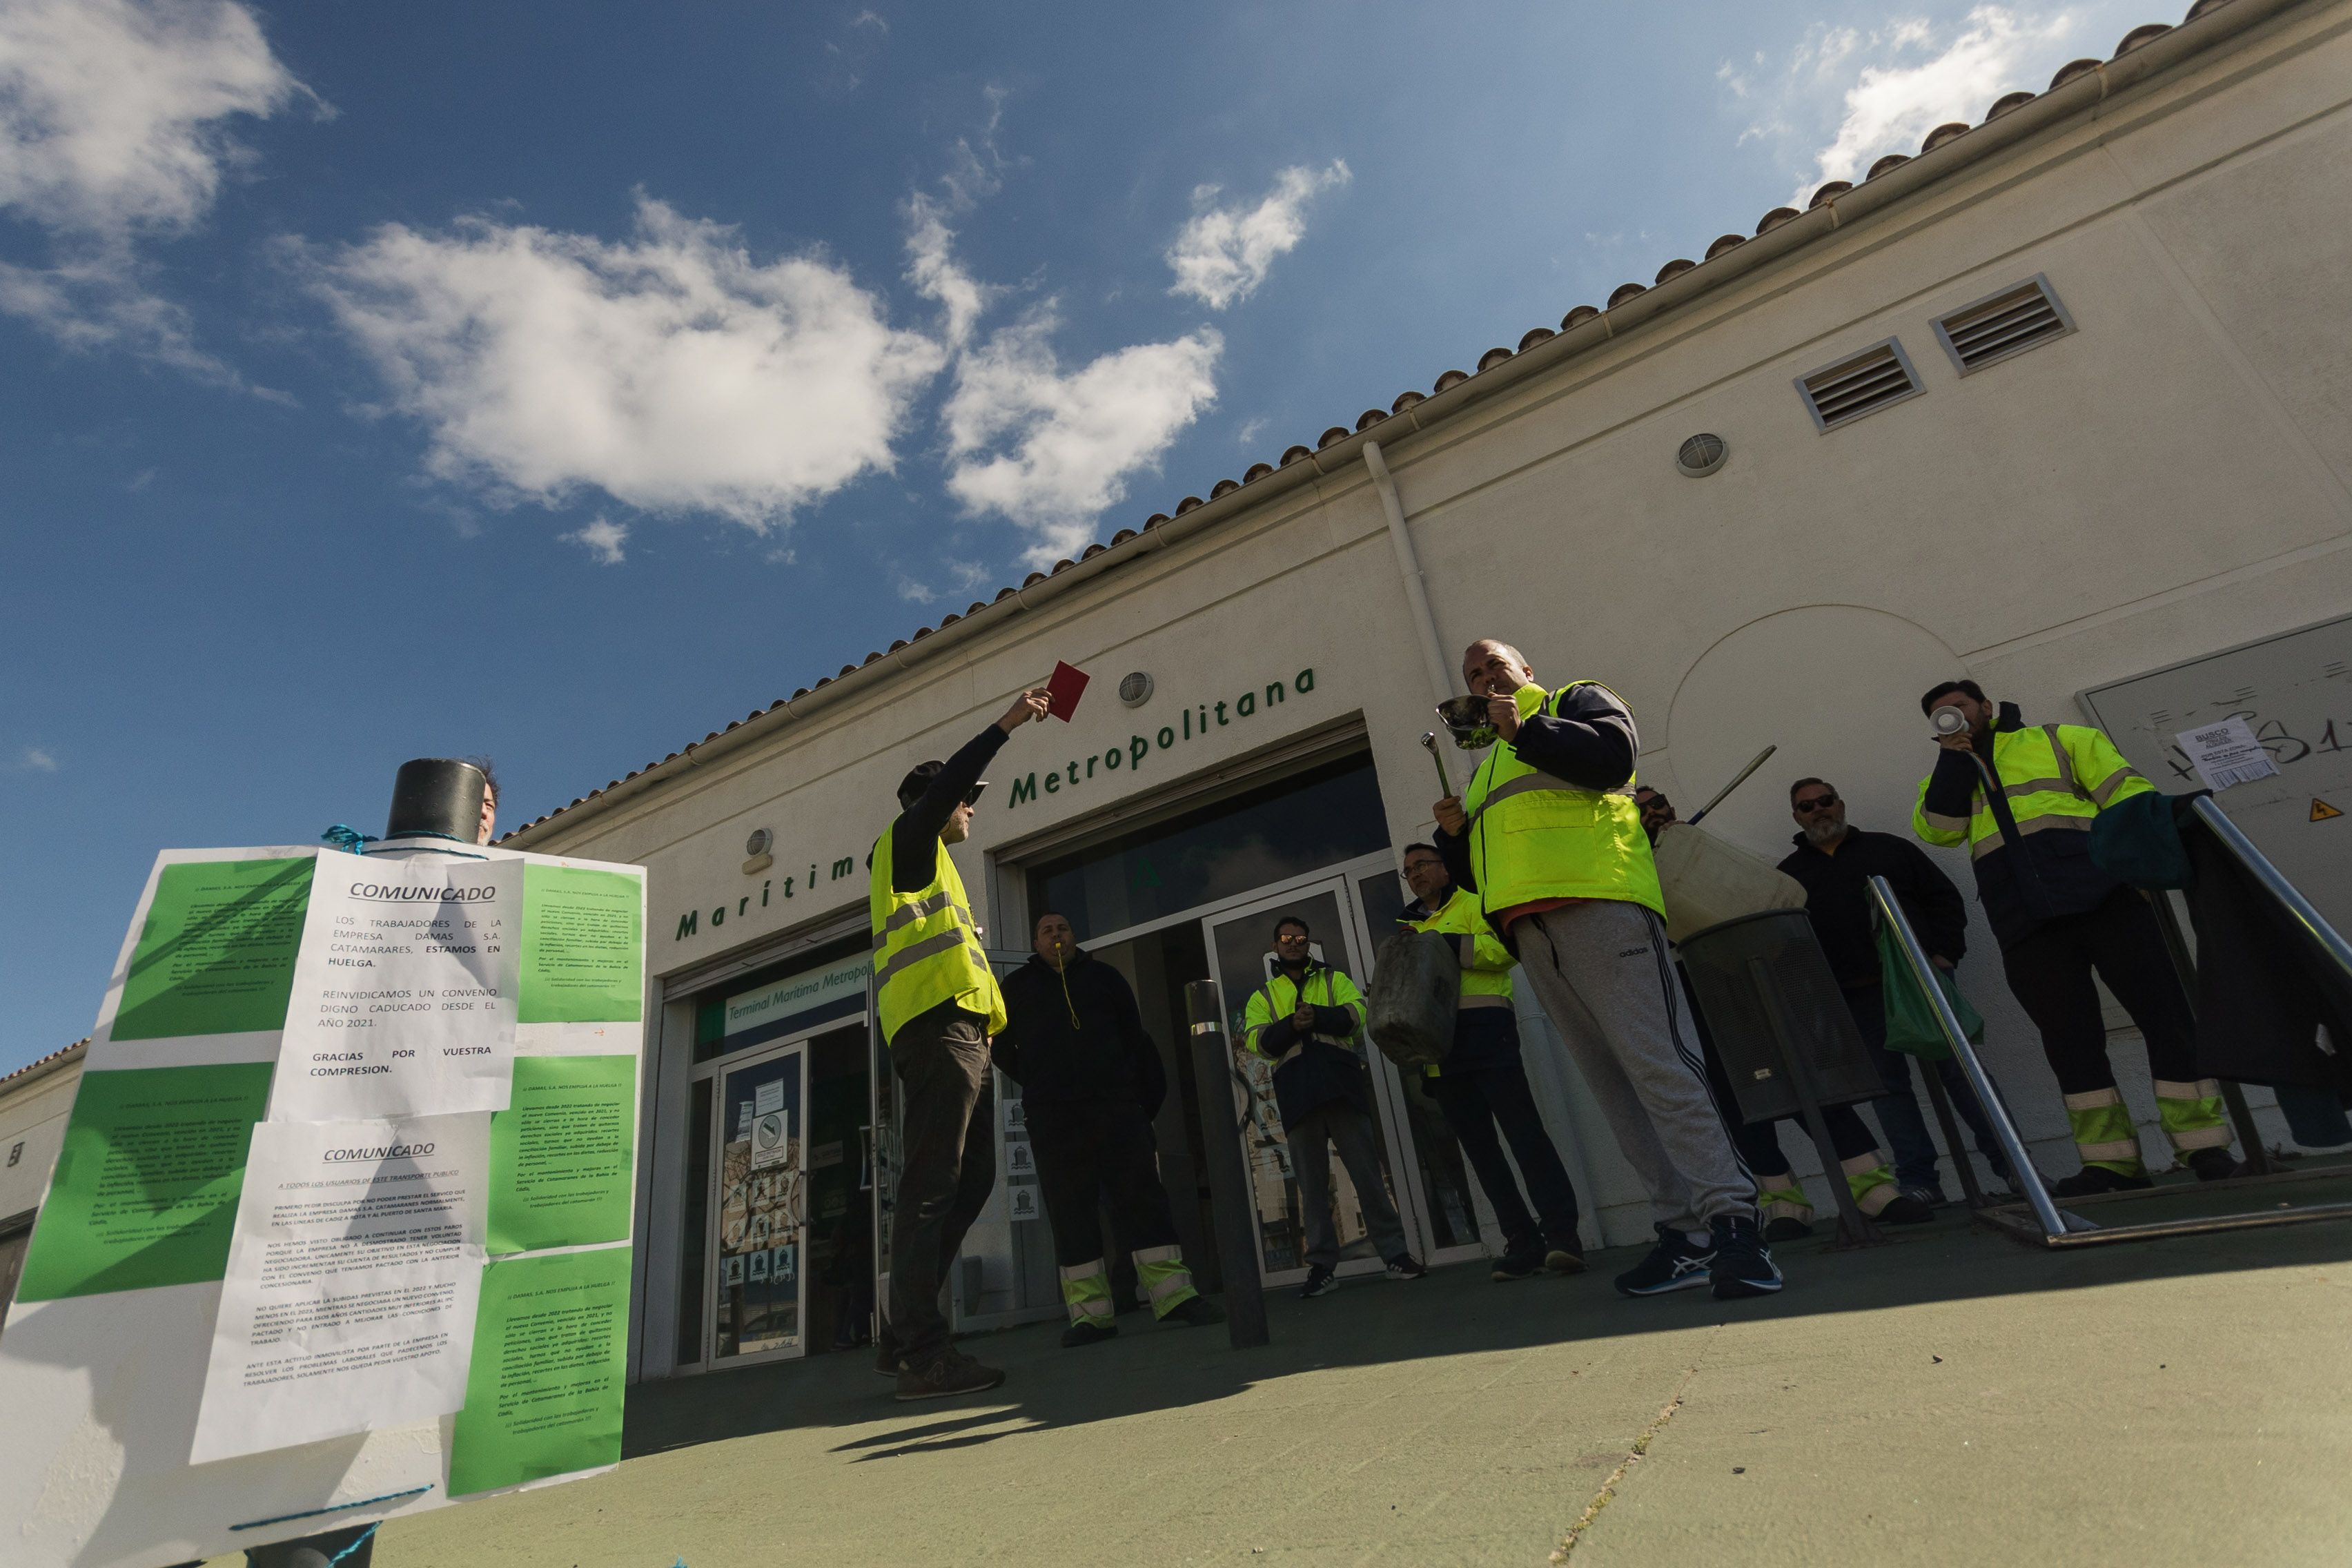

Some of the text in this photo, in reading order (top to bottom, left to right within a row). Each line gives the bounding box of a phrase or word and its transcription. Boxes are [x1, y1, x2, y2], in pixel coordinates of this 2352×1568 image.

[1008, 668, 1314, 809] Metropolitana
[2195, 728, 2229, 743] BUSCO
[350, 883, 496, 901] COMUNICADO
[676, 856, 853, 941] Marítim
[335, 916, 354, 925] LOS
[371, 918, 450, 928] TRABAJADORES
[490, 919, 501, 928] LA
[333, 930, 501, 941] EMPRESA DAMAS S.A.
[331, 944, 500, 954] CATAMARARES, ESTAMOS EN
[1619, 947, 1648, 957] adidas
[329, 958, 377, 967] HUELGA.
[322, 988, 497, 999] REINVIDICAMOS UN CONVENIO
[320, 1001, 496, 1013] DIGNO CADUCADO DESDE EL
[729, 994, 770, 1020] Terminal
[772, 981, 819, 1006] Marítima
[317, 1017, 378, 1028] AÑO 2021.
[313, 1046, 491, 1061] GRACIAS POR VUESTRA
[311, 1066, 393, 1076] COMPRESION.
[324, 1143, 435, 1161] COMUNICADO
[389, 1173, 430, 1181] TRANSPORTE
[375, 1202, 418, 1210] CATAMARANES
[371, 1230, 406, 1238] CONTINUAR
[315, 1251, 354, 1260] UNICAMENTE
[366, 1246, 394, 1254] OBJETIVO
[422, 1238, 461, 1247] NEGOCIACION
[288, 1270, 322, 1278] CONVENIO
[341, 1264, 372, 1272] TENIAMOS
[431, 1253, 460, 1262] ANTERIOR
[291, 1260, 335, 1270] INCREMENTAR
[381, 1251, 418, 1260] RESULTADOS
[244, 1368, 277, 1378] RESOLVER
[299, 1359, 337, 1370] PROBLEMAS
[341, 1353, 377, 1363] LABORALES
[398, 1342, 433, 1354] PADECEMOS
[297, 1368, 333, 1378] SOLAMENTE
[351, 1362, 371, 1370] QUEDA
[393, 1353, 418, 1362] VUESTRO
